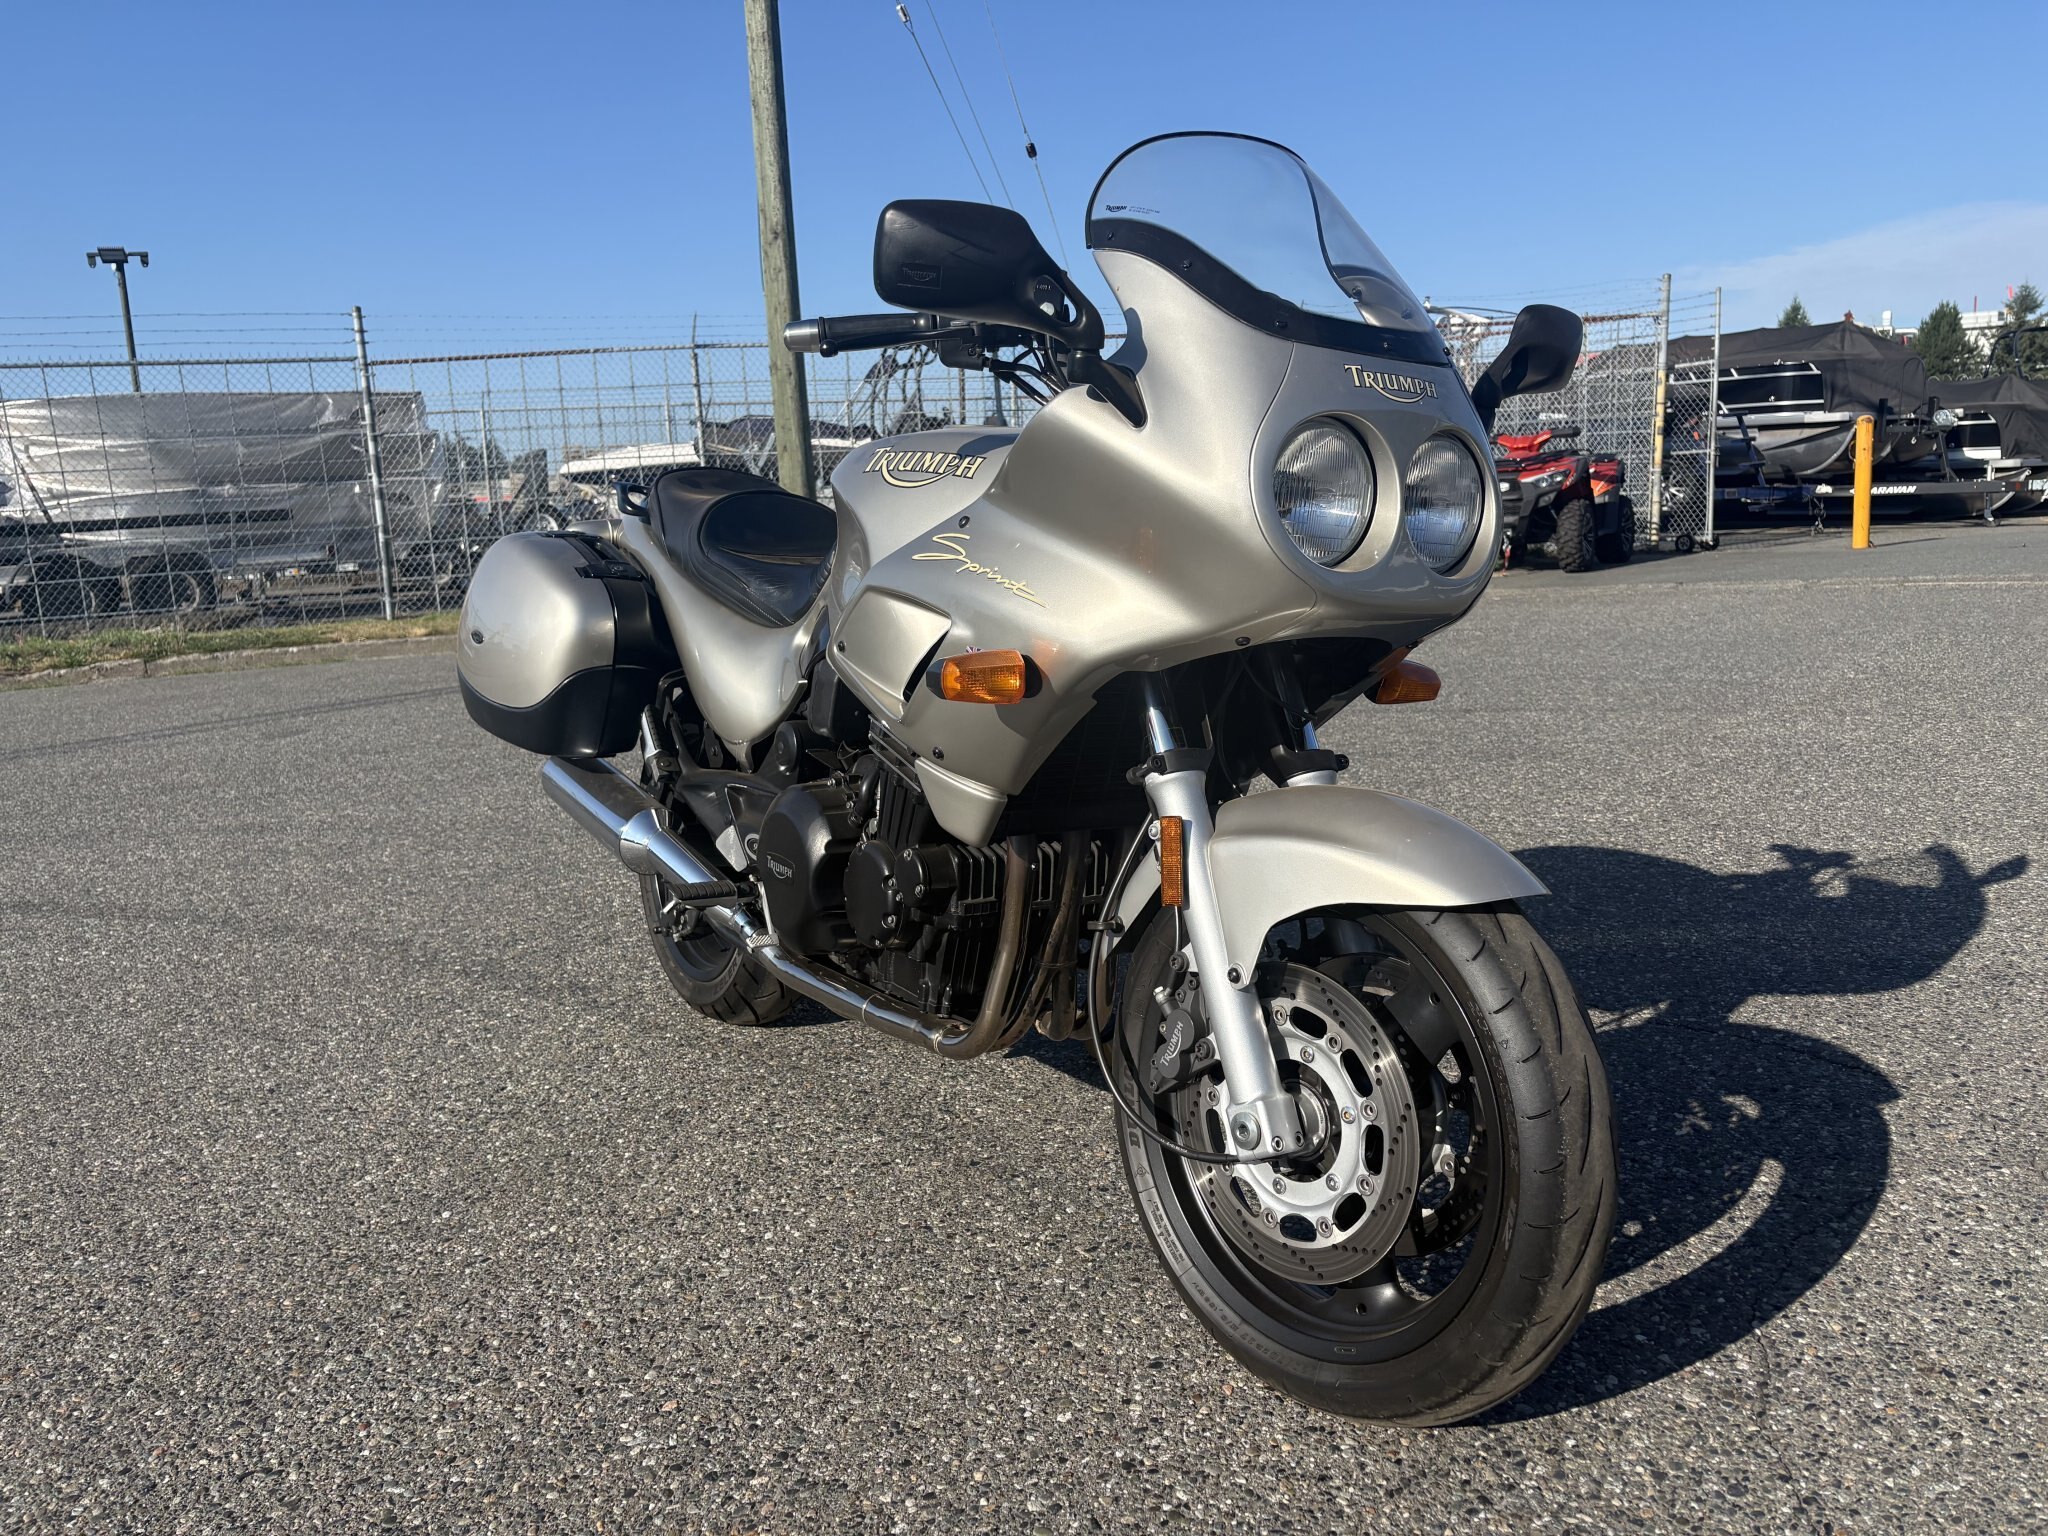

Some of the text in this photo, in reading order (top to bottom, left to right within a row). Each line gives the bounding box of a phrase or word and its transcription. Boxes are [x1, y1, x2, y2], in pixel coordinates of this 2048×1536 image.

[1343, 363, 1439, 404] TRIUMPH
[862, 445, 987, 488] TRIUMPH
[1850, 485, 1918, 496] ARAVAN
[911, 532, 1050, 609] Sprint
[766, 854, 793, 879] TRIUMPH
[1159, 1020, 1184, 1067] TRIUMPH
